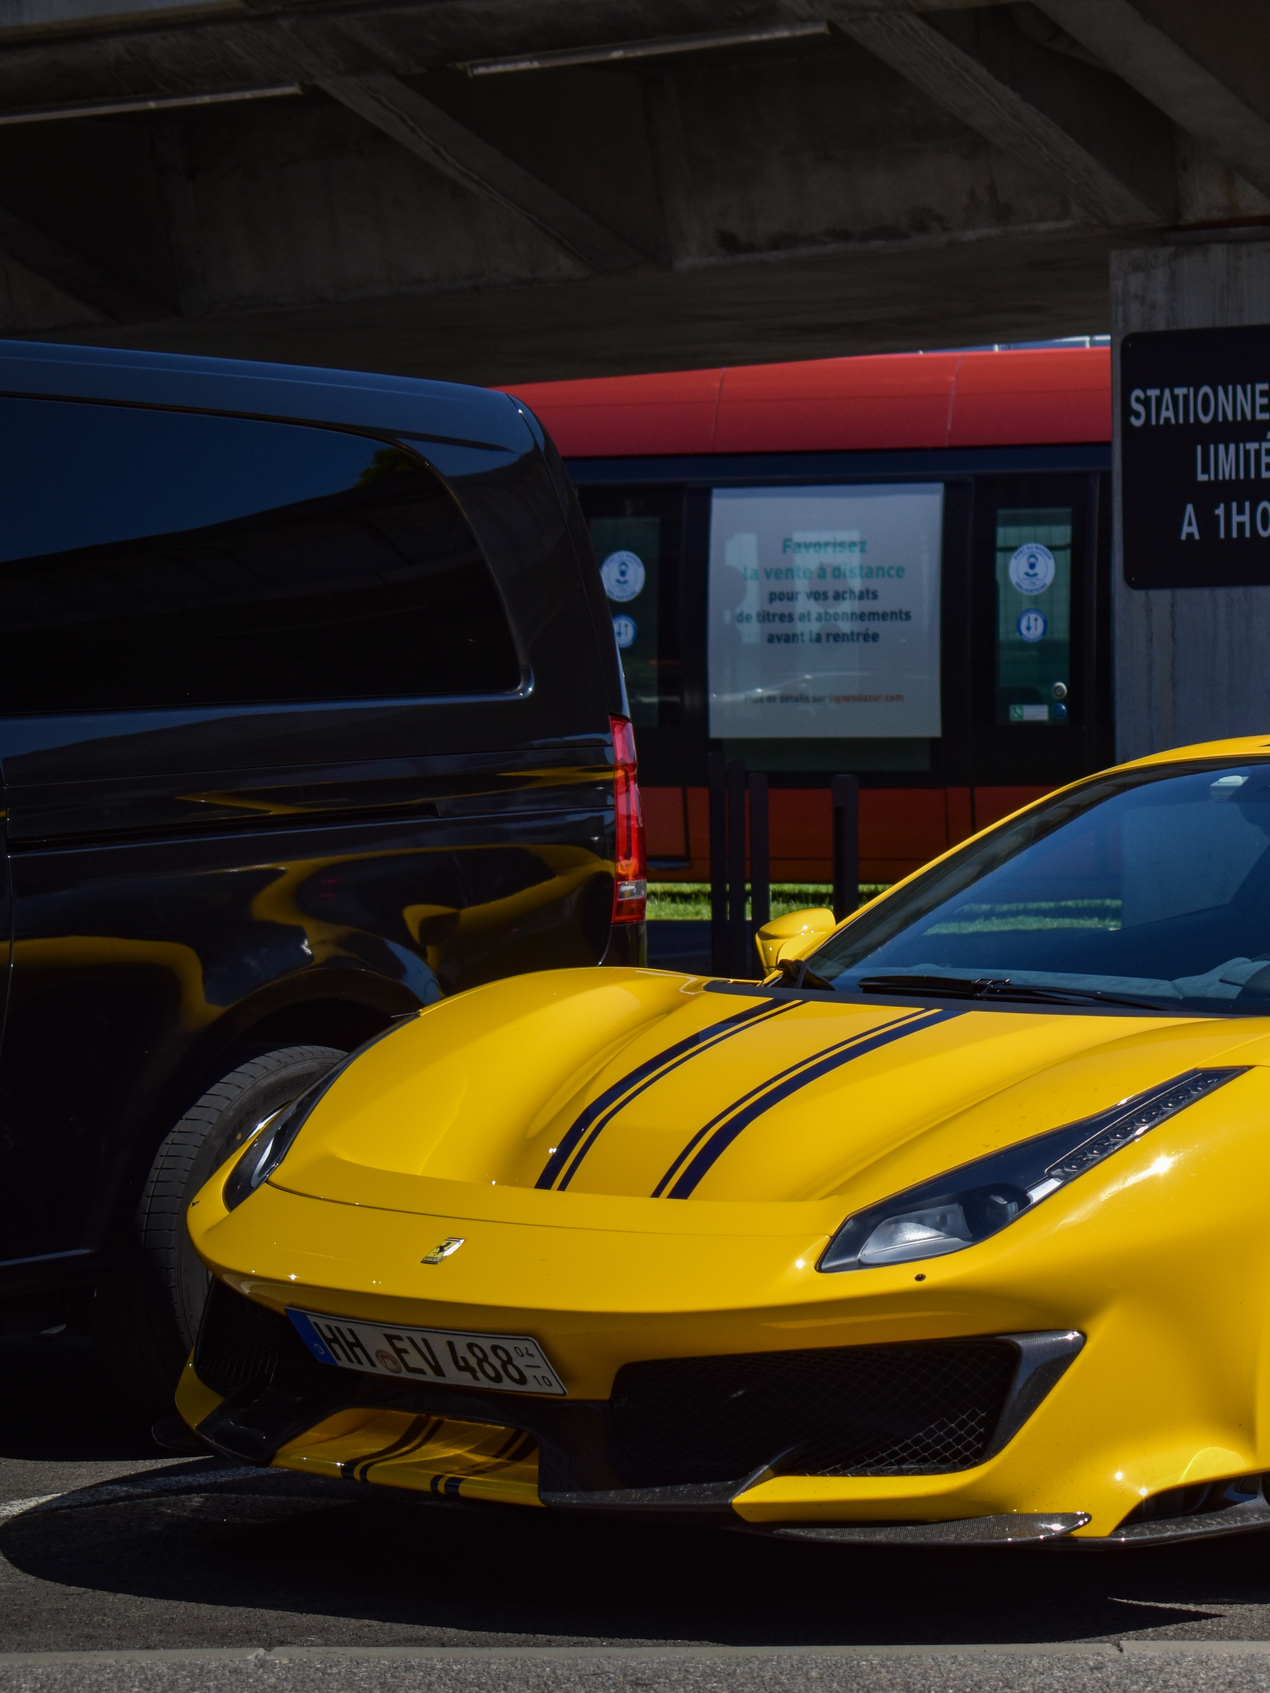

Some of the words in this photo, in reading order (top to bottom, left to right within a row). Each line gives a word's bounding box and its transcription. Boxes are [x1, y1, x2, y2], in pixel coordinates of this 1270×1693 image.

[1180, 503, 1200, 541] A
[782, 537, 868, 554] Favorisez
[743, 565, 759, 581] la
[764, 565, 812, 581] vente
[817, 562, 827, 579] à
[831, 564, 906, 579] distance
[769, 590, 801, 604] pour
[806, 590, 829, 601] vos
[832, 588, 879, 600] achats
[736, 610, 752, 623] de
[756, 610, 794, 623] titres
[798, 610, 811, 623] et
[815, 609, 911, 623] abonnements
[767, 631, 806, 644] avant
[809, 630, 822, 643] la
[826, 628, 880, 643] rentrée
[312, 1321, 377, 1368] HH
[382, 1333, 446, 1377] EV
[447, 1340, 527, 1386] 488
[313, 1342, 325, 1355] D
[514, 1346, 534, 1358] 04
[533, 1375, 553, 1387] 10
